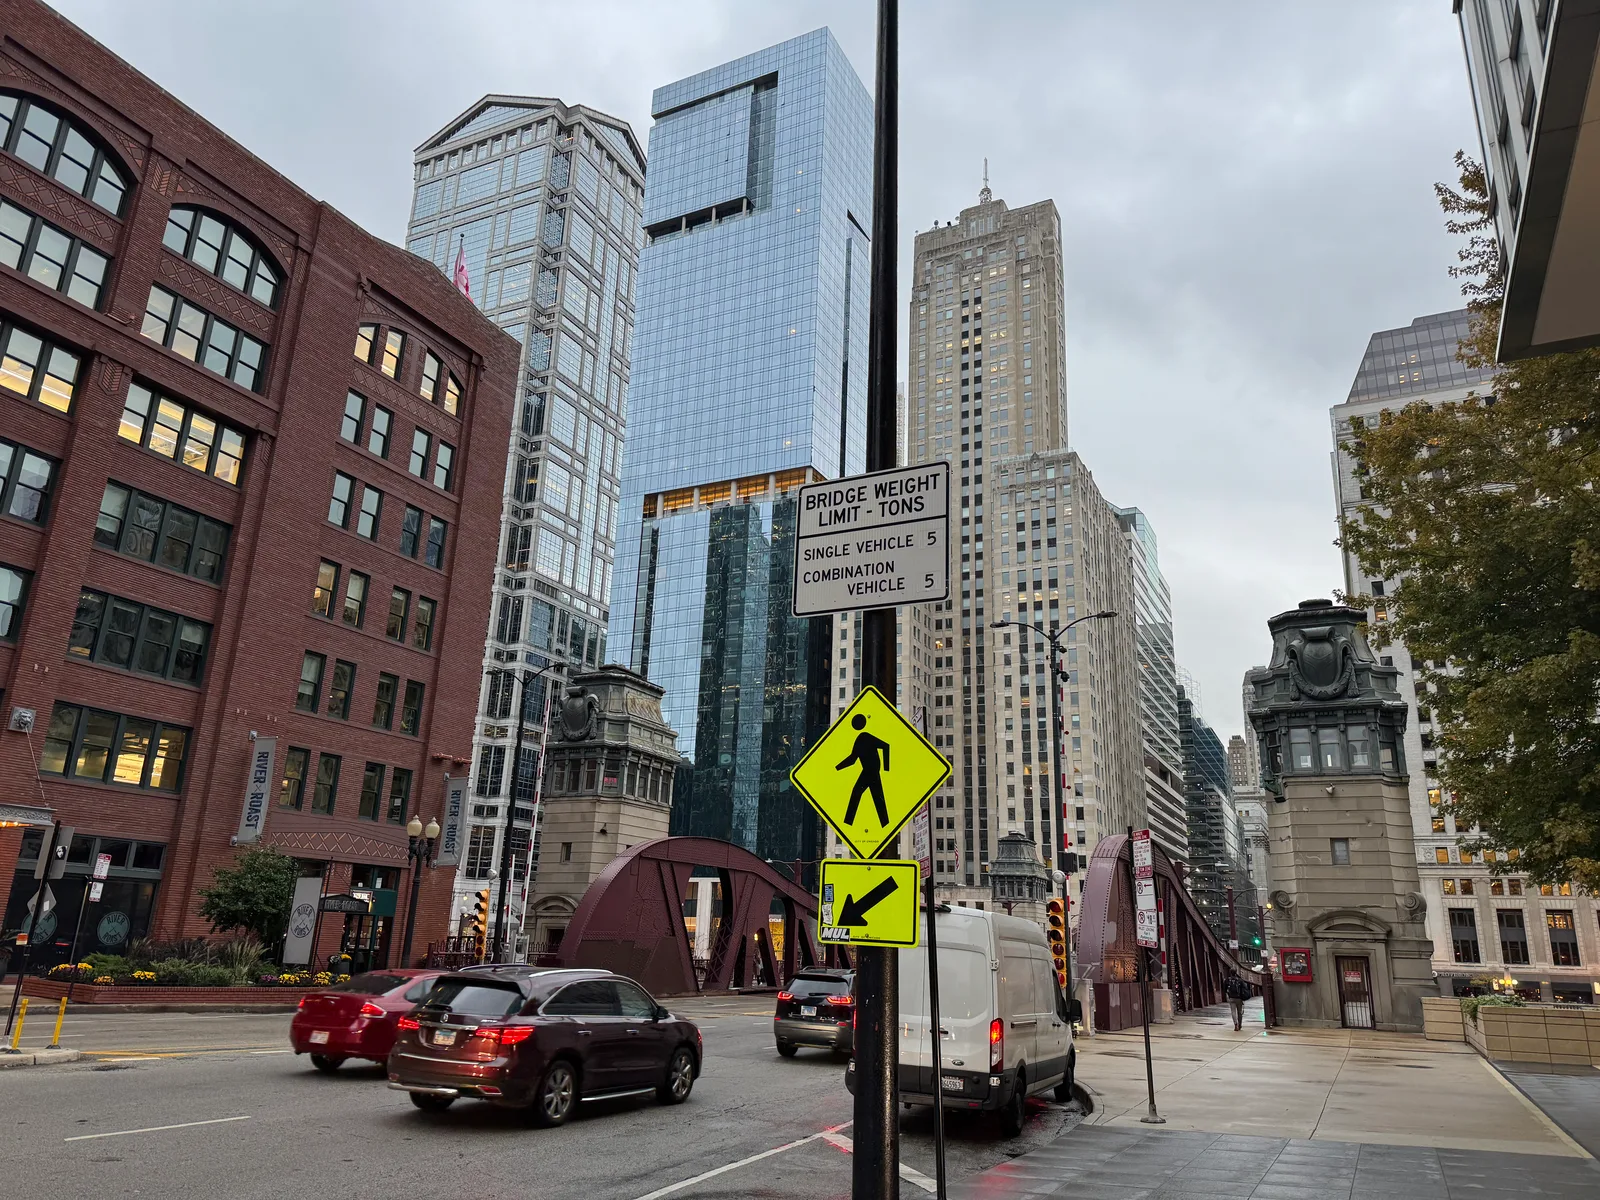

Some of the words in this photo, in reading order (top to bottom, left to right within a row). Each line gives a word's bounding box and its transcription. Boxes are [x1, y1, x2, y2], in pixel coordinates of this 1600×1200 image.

[805, 485, 868, 511] BRIDGE
[874, 472, 941, 500] WEIGHT
[818, 505, 861, 527] LIMIT
[878, 495, 925, 518] TONS
[803, 543, 851, 561] SINGLE
[856, 534, 914, 554] VEHICLE
[926, 531, 937, 546] 5
[803, 560, 895, 584] COMBINATION
[847, 577, 905, 596] VEHICLE
[924, 573, 934, 588] 5
[253, 751, 269, 784] RIVER
[245, 792, 264, 829] ROAST
[448, 789, 462, 817] RIVER
[443, 823, 458, 856] ROAST
[106, 914, 126, 925] RIVER
[297, 905, 313, 918] RIVER
[101, 931, 122, 943] ROAST
[822, 927, 850, 940] MUL
